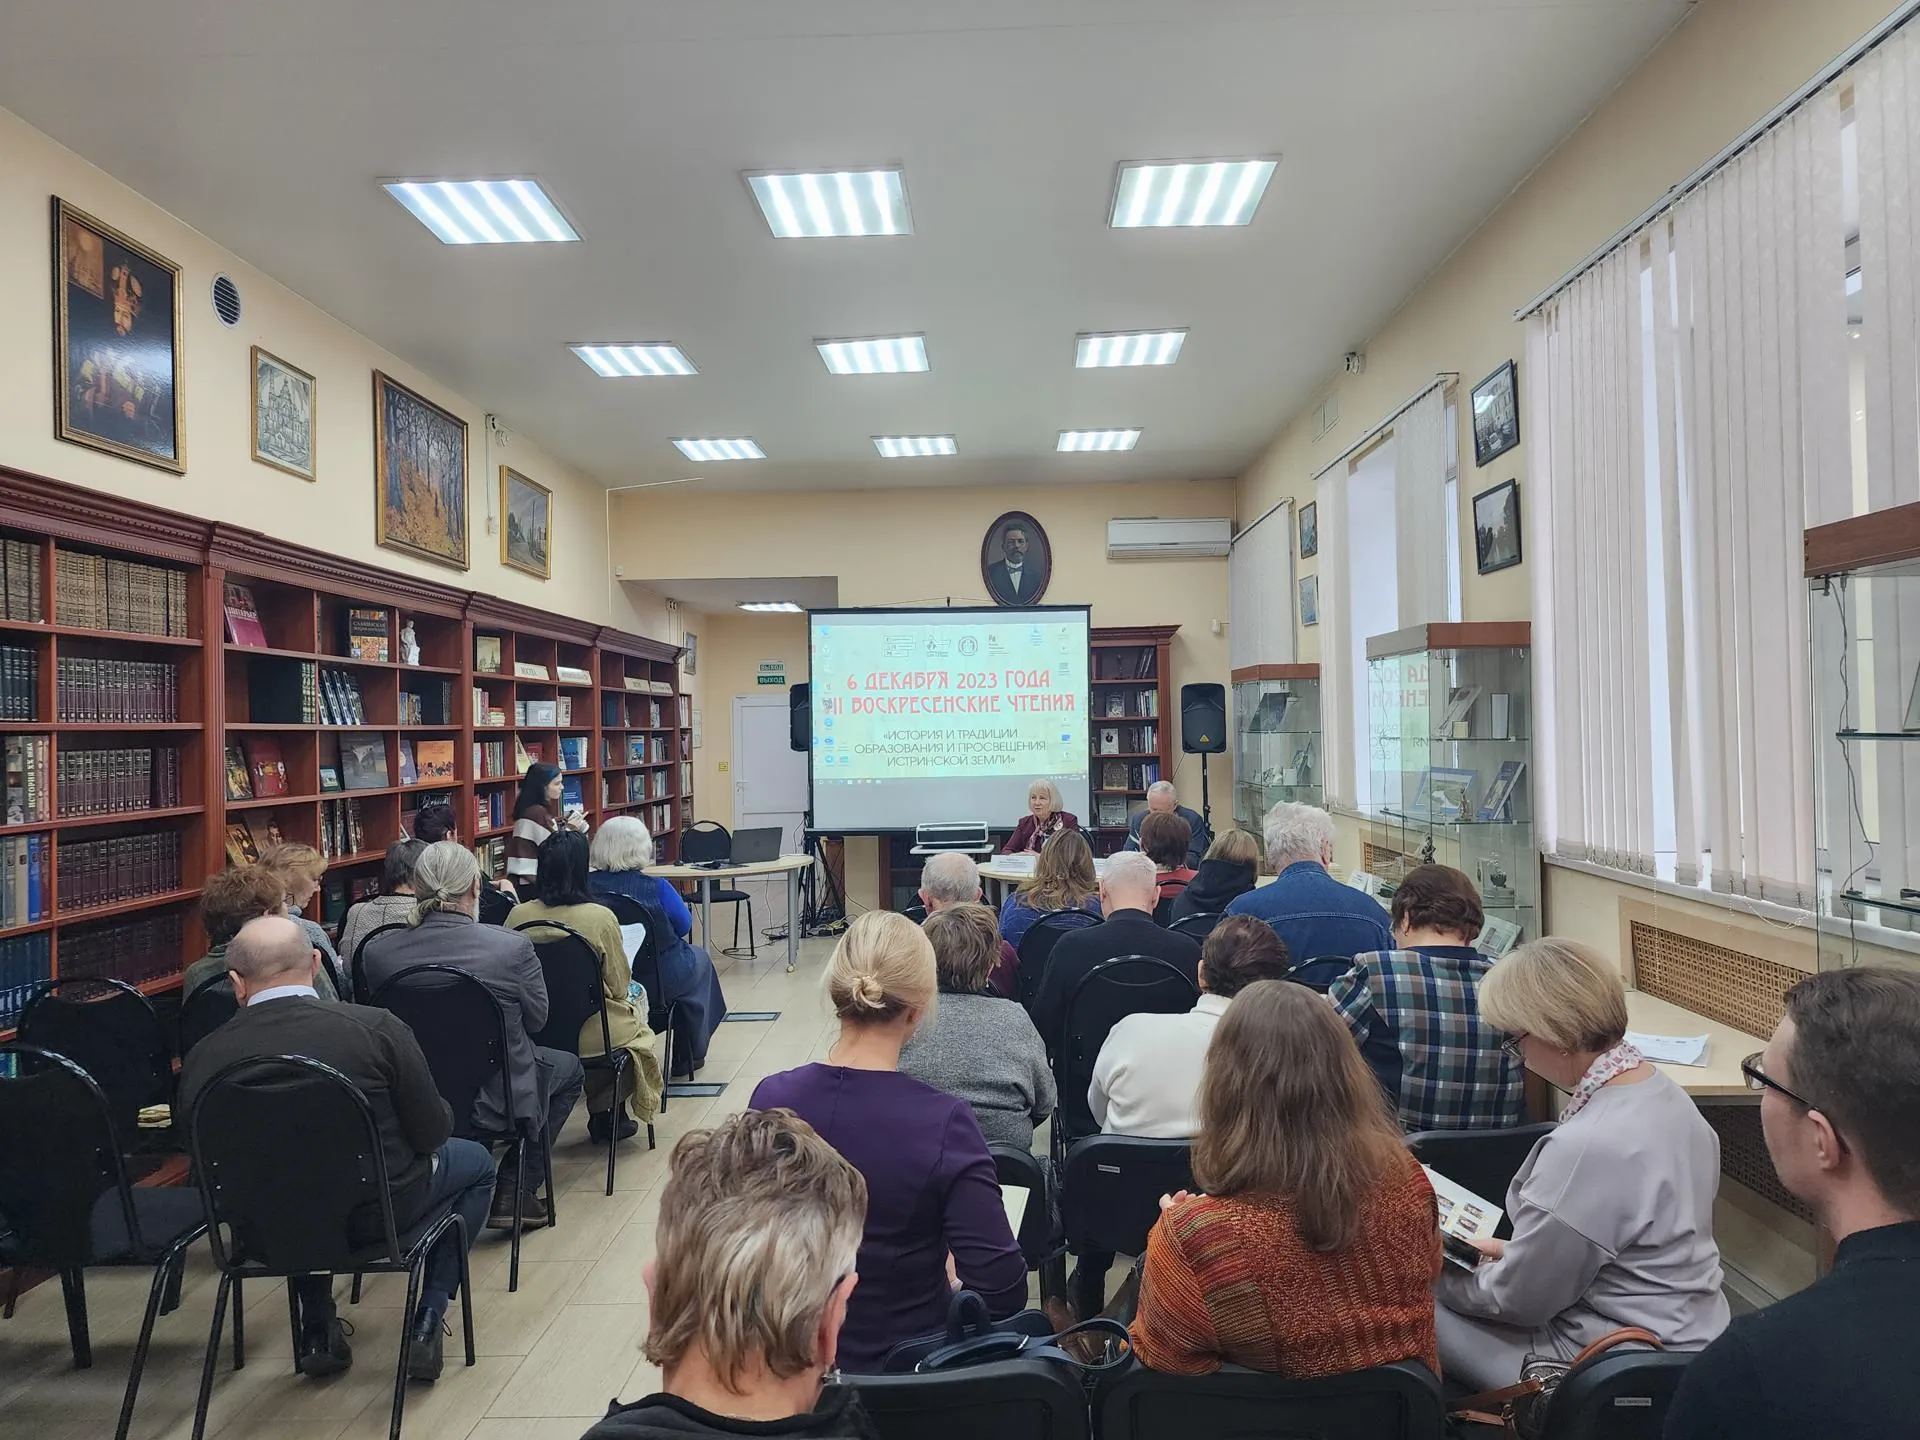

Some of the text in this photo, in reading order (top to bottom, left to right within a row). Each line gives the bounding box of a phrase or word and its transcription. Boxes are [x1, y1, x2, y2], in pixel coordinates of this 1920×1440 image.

[847, 670, 1050, 690] 6 ДЕКАБРЯ 2023 ГОДА
[852, 695, 1000, 714] ВОСКРЕСЕНСКИЕ
[1007, 694, 1075, 712] ЧТЕНИЯ
[883, 728, 1018, 740] «ИСТОРИЯ И ТРАДИЦИИ
[854, 740, 1046, 754] ОБРАЗОВАНИЯ И ПРОСВЕЩЕНИЯ
[887, 754, 1016, 767] ИСТРИНСКОЙ ЗЕМЛИ»
